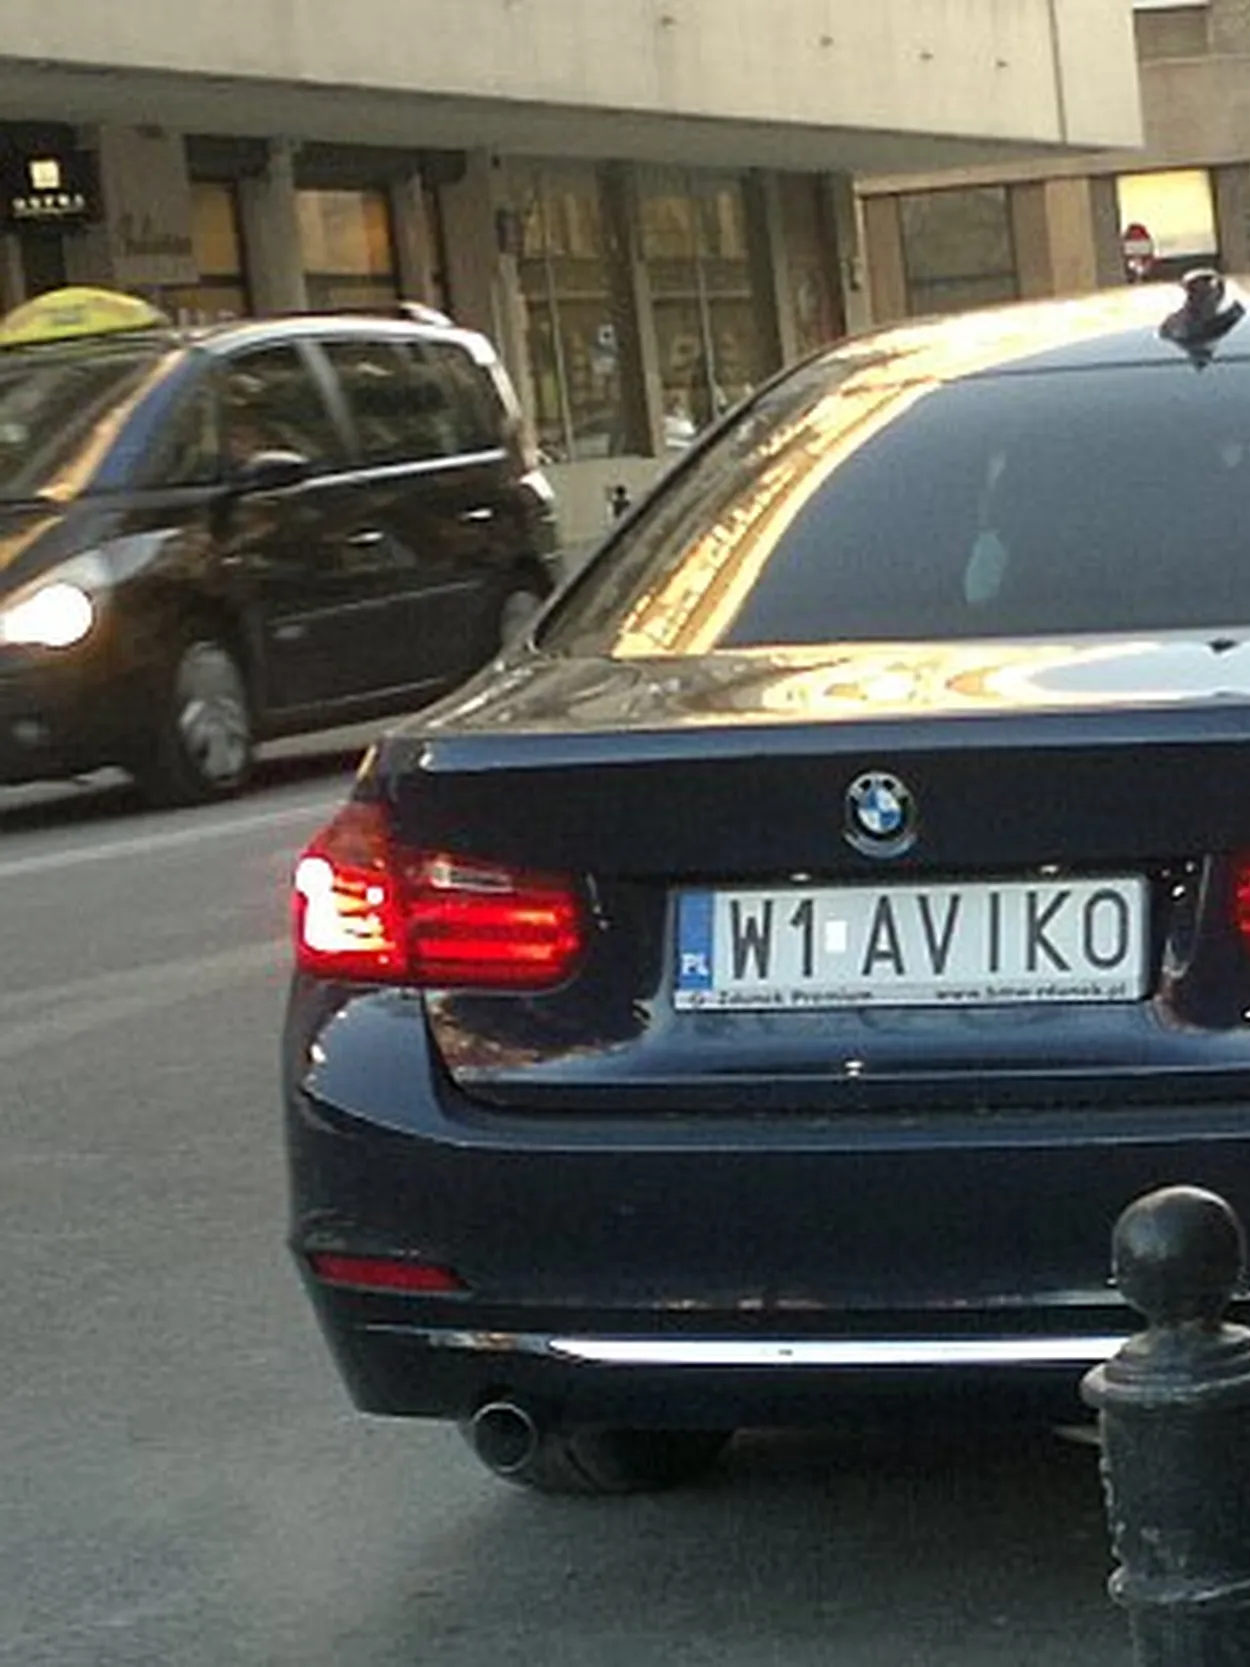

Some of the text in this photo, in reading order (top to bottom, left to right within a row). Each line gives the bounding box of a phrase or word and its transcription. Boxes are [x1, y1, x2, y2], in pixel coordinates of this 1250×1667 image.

[730, 889, 1130, 980] W1 AVIKO
[681, 953, 709, 976] PL
